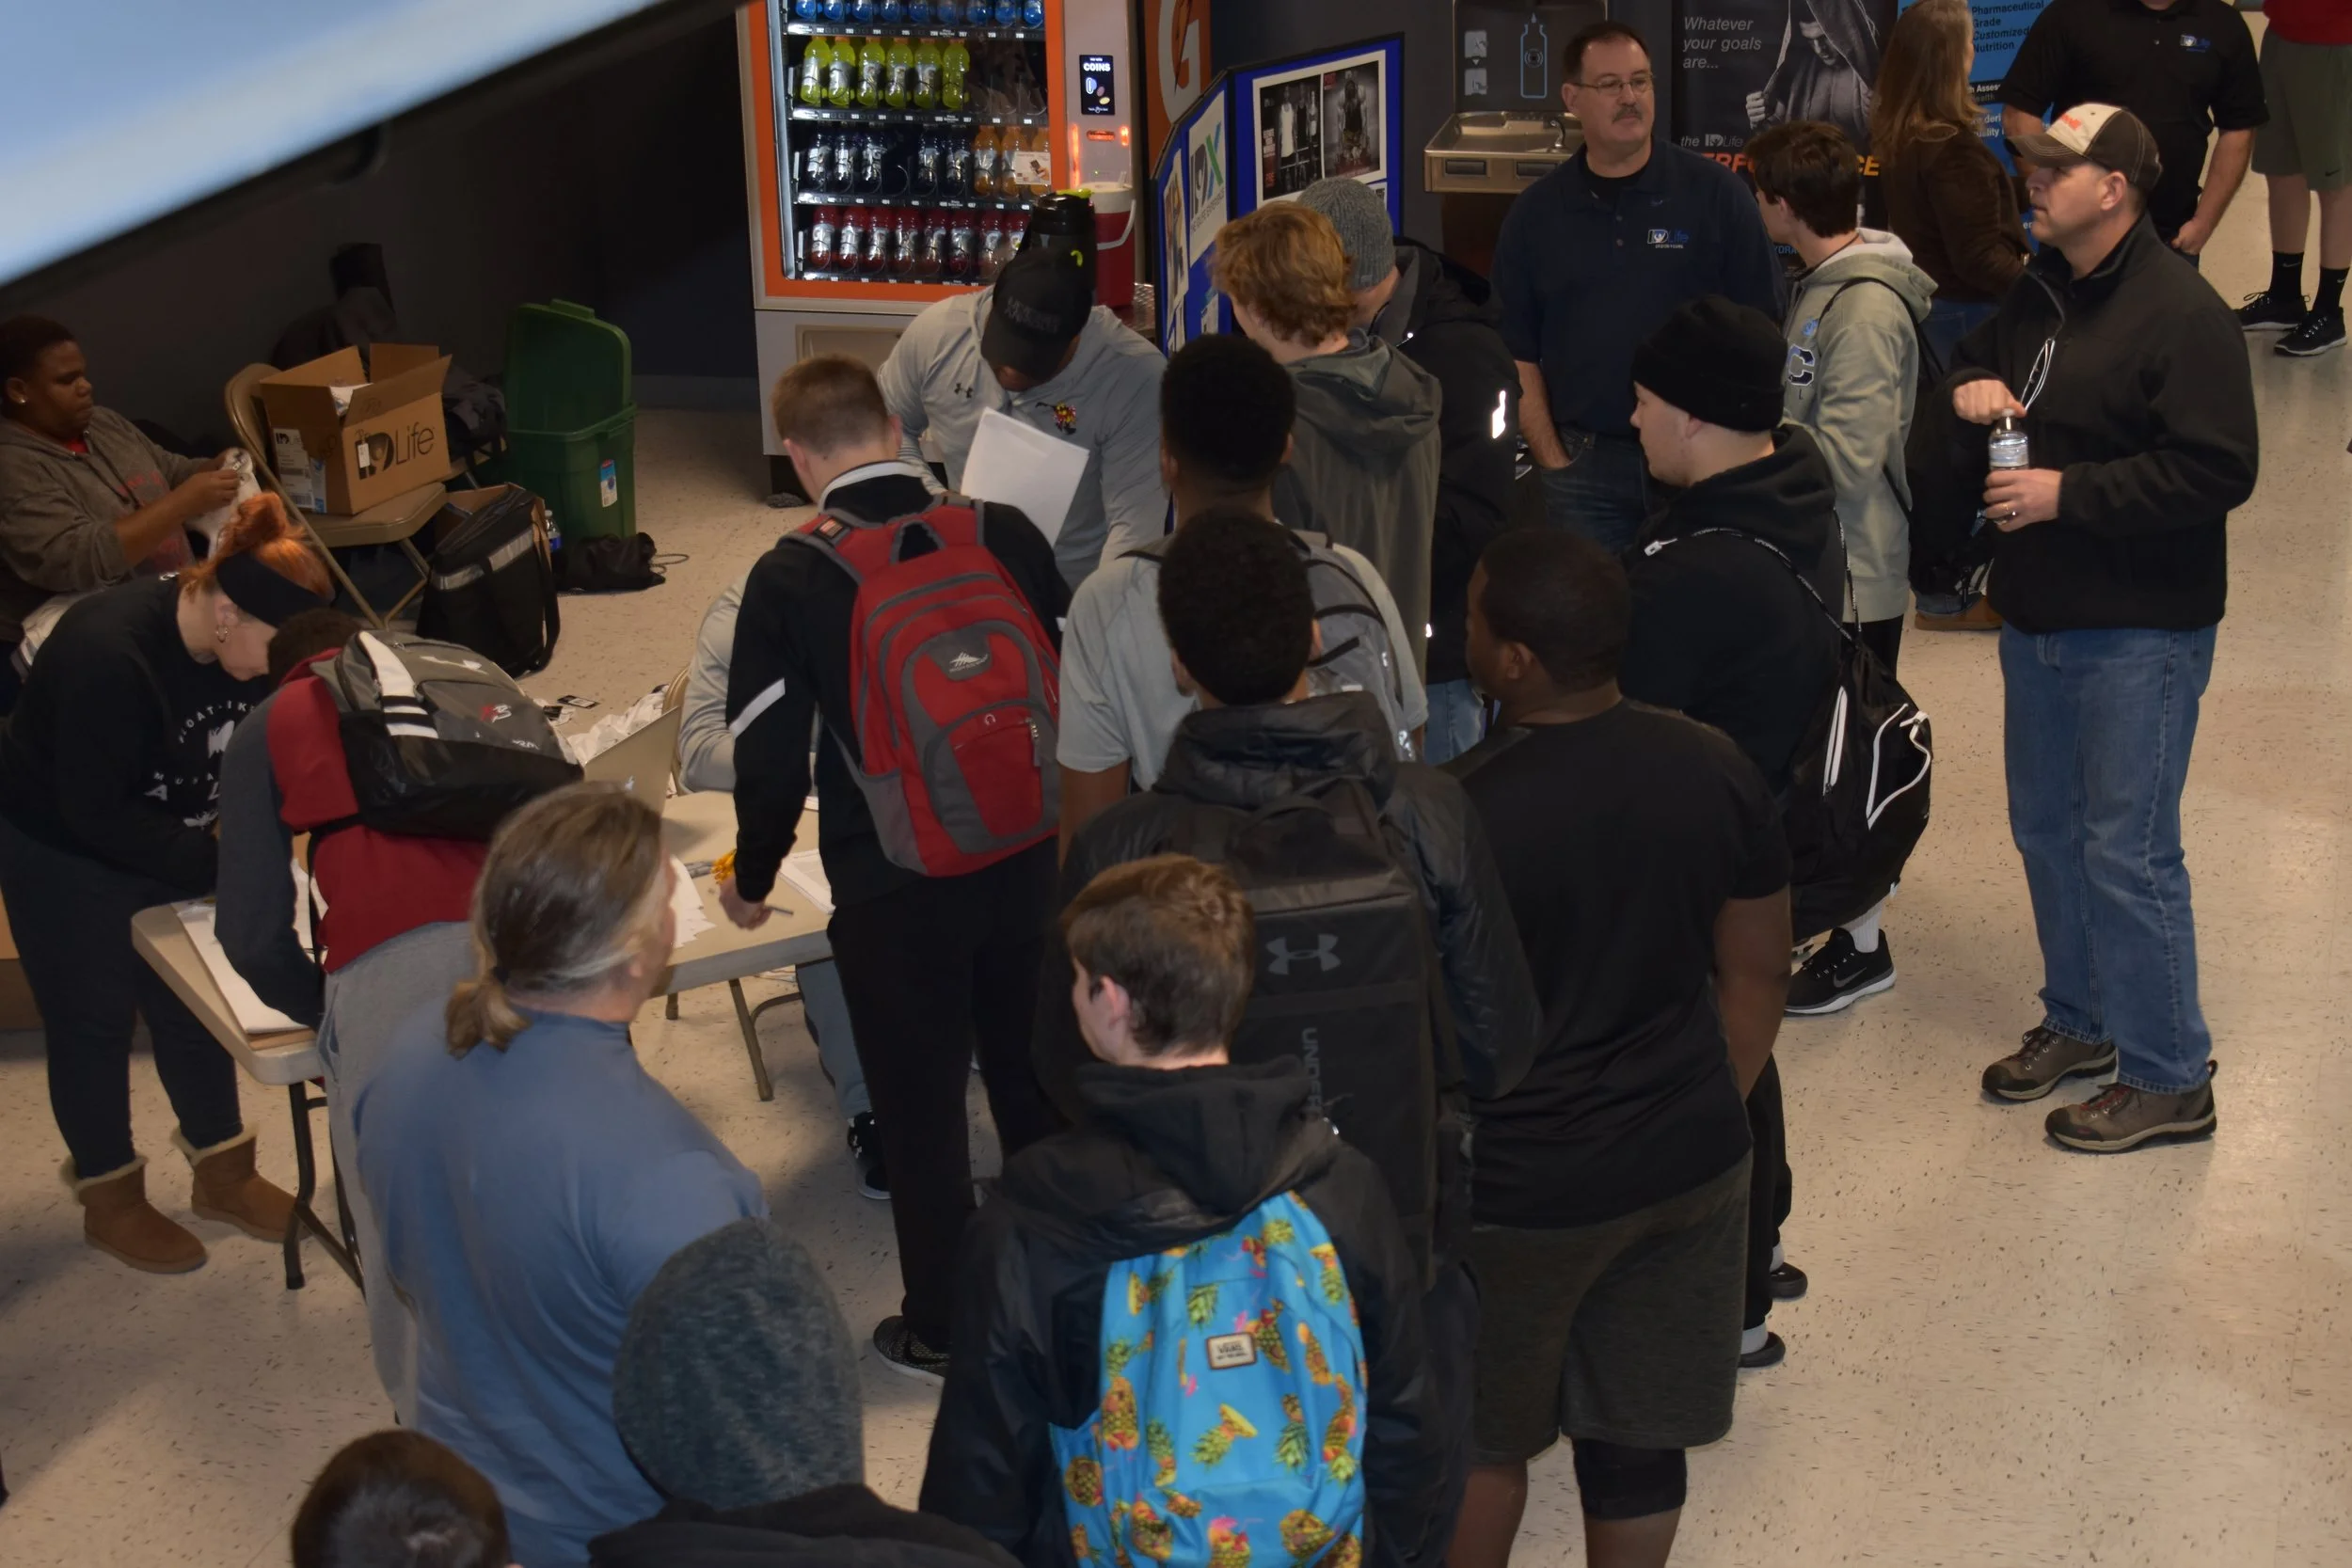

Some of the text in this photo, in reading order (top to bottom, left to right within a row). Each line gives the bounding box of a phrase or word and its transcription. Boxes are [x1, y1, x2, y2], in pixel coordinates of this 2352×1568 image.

[1972, 1, 2044, 15] Pharmaceutical
[1684, 16, 1754, 31] Whatever
[1973, 18, 2001, 28] Grade
[1973, 27, 2030, 40] Customized
[1682, 37, 1762, 53] your goals
[1083, 62, 1111, 71] COINS
[1682, 57, 1719, 70] are...
[1680, 135, 1700, 147] the
